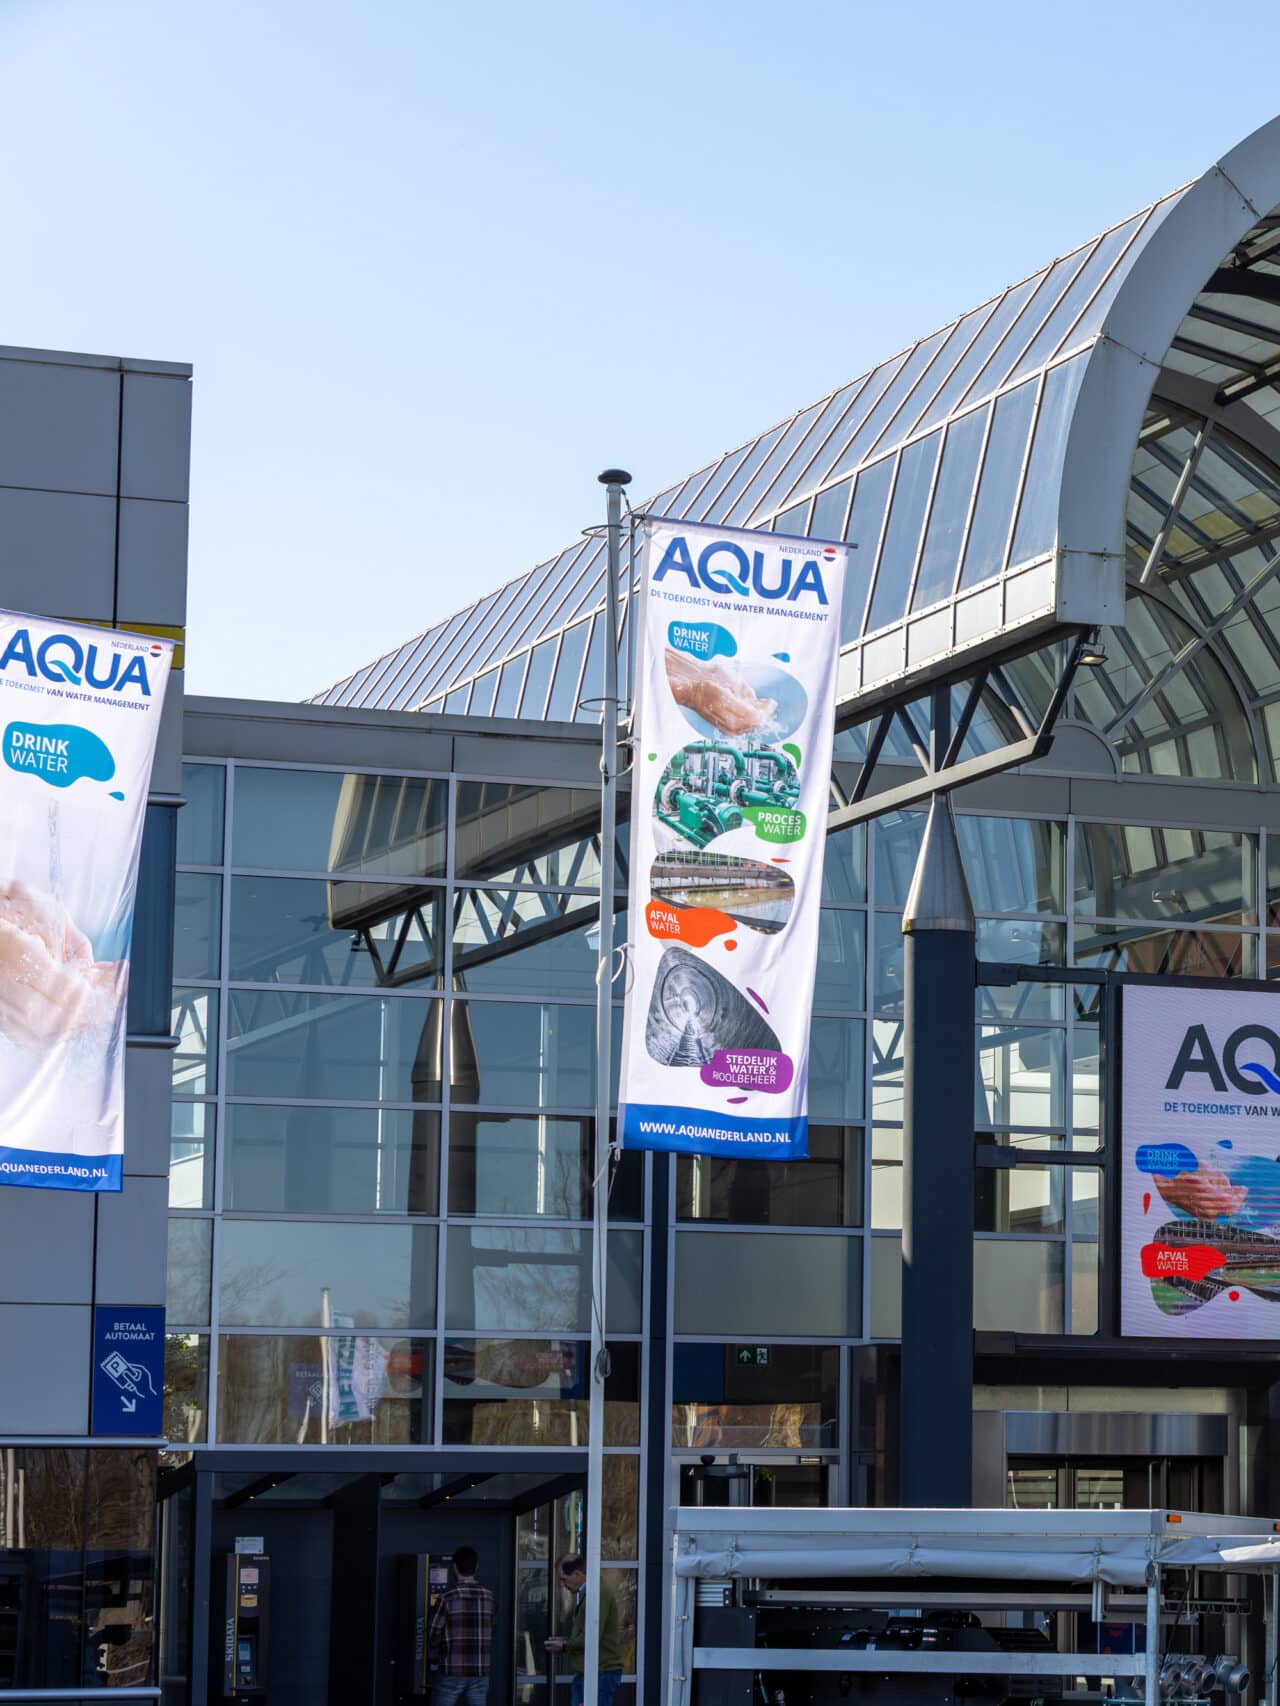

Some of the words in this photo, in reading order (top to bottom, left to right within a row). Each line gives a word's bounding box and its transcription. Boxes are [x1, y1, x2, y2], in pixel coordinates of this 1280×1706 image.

[779, 545, 822, 557] NEDERLAND
[652, 536, 829, 605] AQUA
[650, 588, 661, 598] DE
[663, 592, 711, 607] TOEKOMST
[712, 600, 732, 611] VAN
[733, 603, 765, 615] WATER
[766, 607, 830, 622] MANAGEMENT
[673, 626, 710, 642] DRINK
[111, 641, 149, 652] NEDERLAND
[673, 637, 710, 653] WATER
[0, 629, 152, 697] AQUA
[5, 679, 44, 694] TOEKOMST
[46, 687, 63, 698] VAN
[65, 690, 93, 702] WATER
[93, 695, 151, 711] MANAGEMENT
[12, 731, 70, 755] DRINK
[10, 748, 69, 774] WATER
[758, 811, 801, 825] PROCES
[763, 823, 801, 836] WATER
[650, 909, 679, 924] AFVAL
[650, 920, 681, 935] WATER
[726, 1054, 777, 1068] STEDELIJK
[712, 1070, 777, 1084] ROOLBEHEER
[730, 1064, 766, 1075] WATER
[768, 1066, 777, 1075] &
[1164, 1102, 1179, 1112] DE
[1182, 1102, 1242, 1115] TOEKOMST
[1244, 1105, 1268, 1117] VAN
[640, 1121, 792, 1143] WWW.AQUANEDERLAND.NL
[1147, 1150, 1180, 1161] DRINK
[0, 1162, 108, 1178] QUANEDERLAND.NL
[1157, 1251, 1189, 1261] AFVAL
[1157, 1261, 1189, 1271] WATER
[114, 1322, 147, 1331] BETAAL
[105, 1332, 156, 1341] AUTOMAAT
[225, 1617, 235, 1662] SKIDATA
